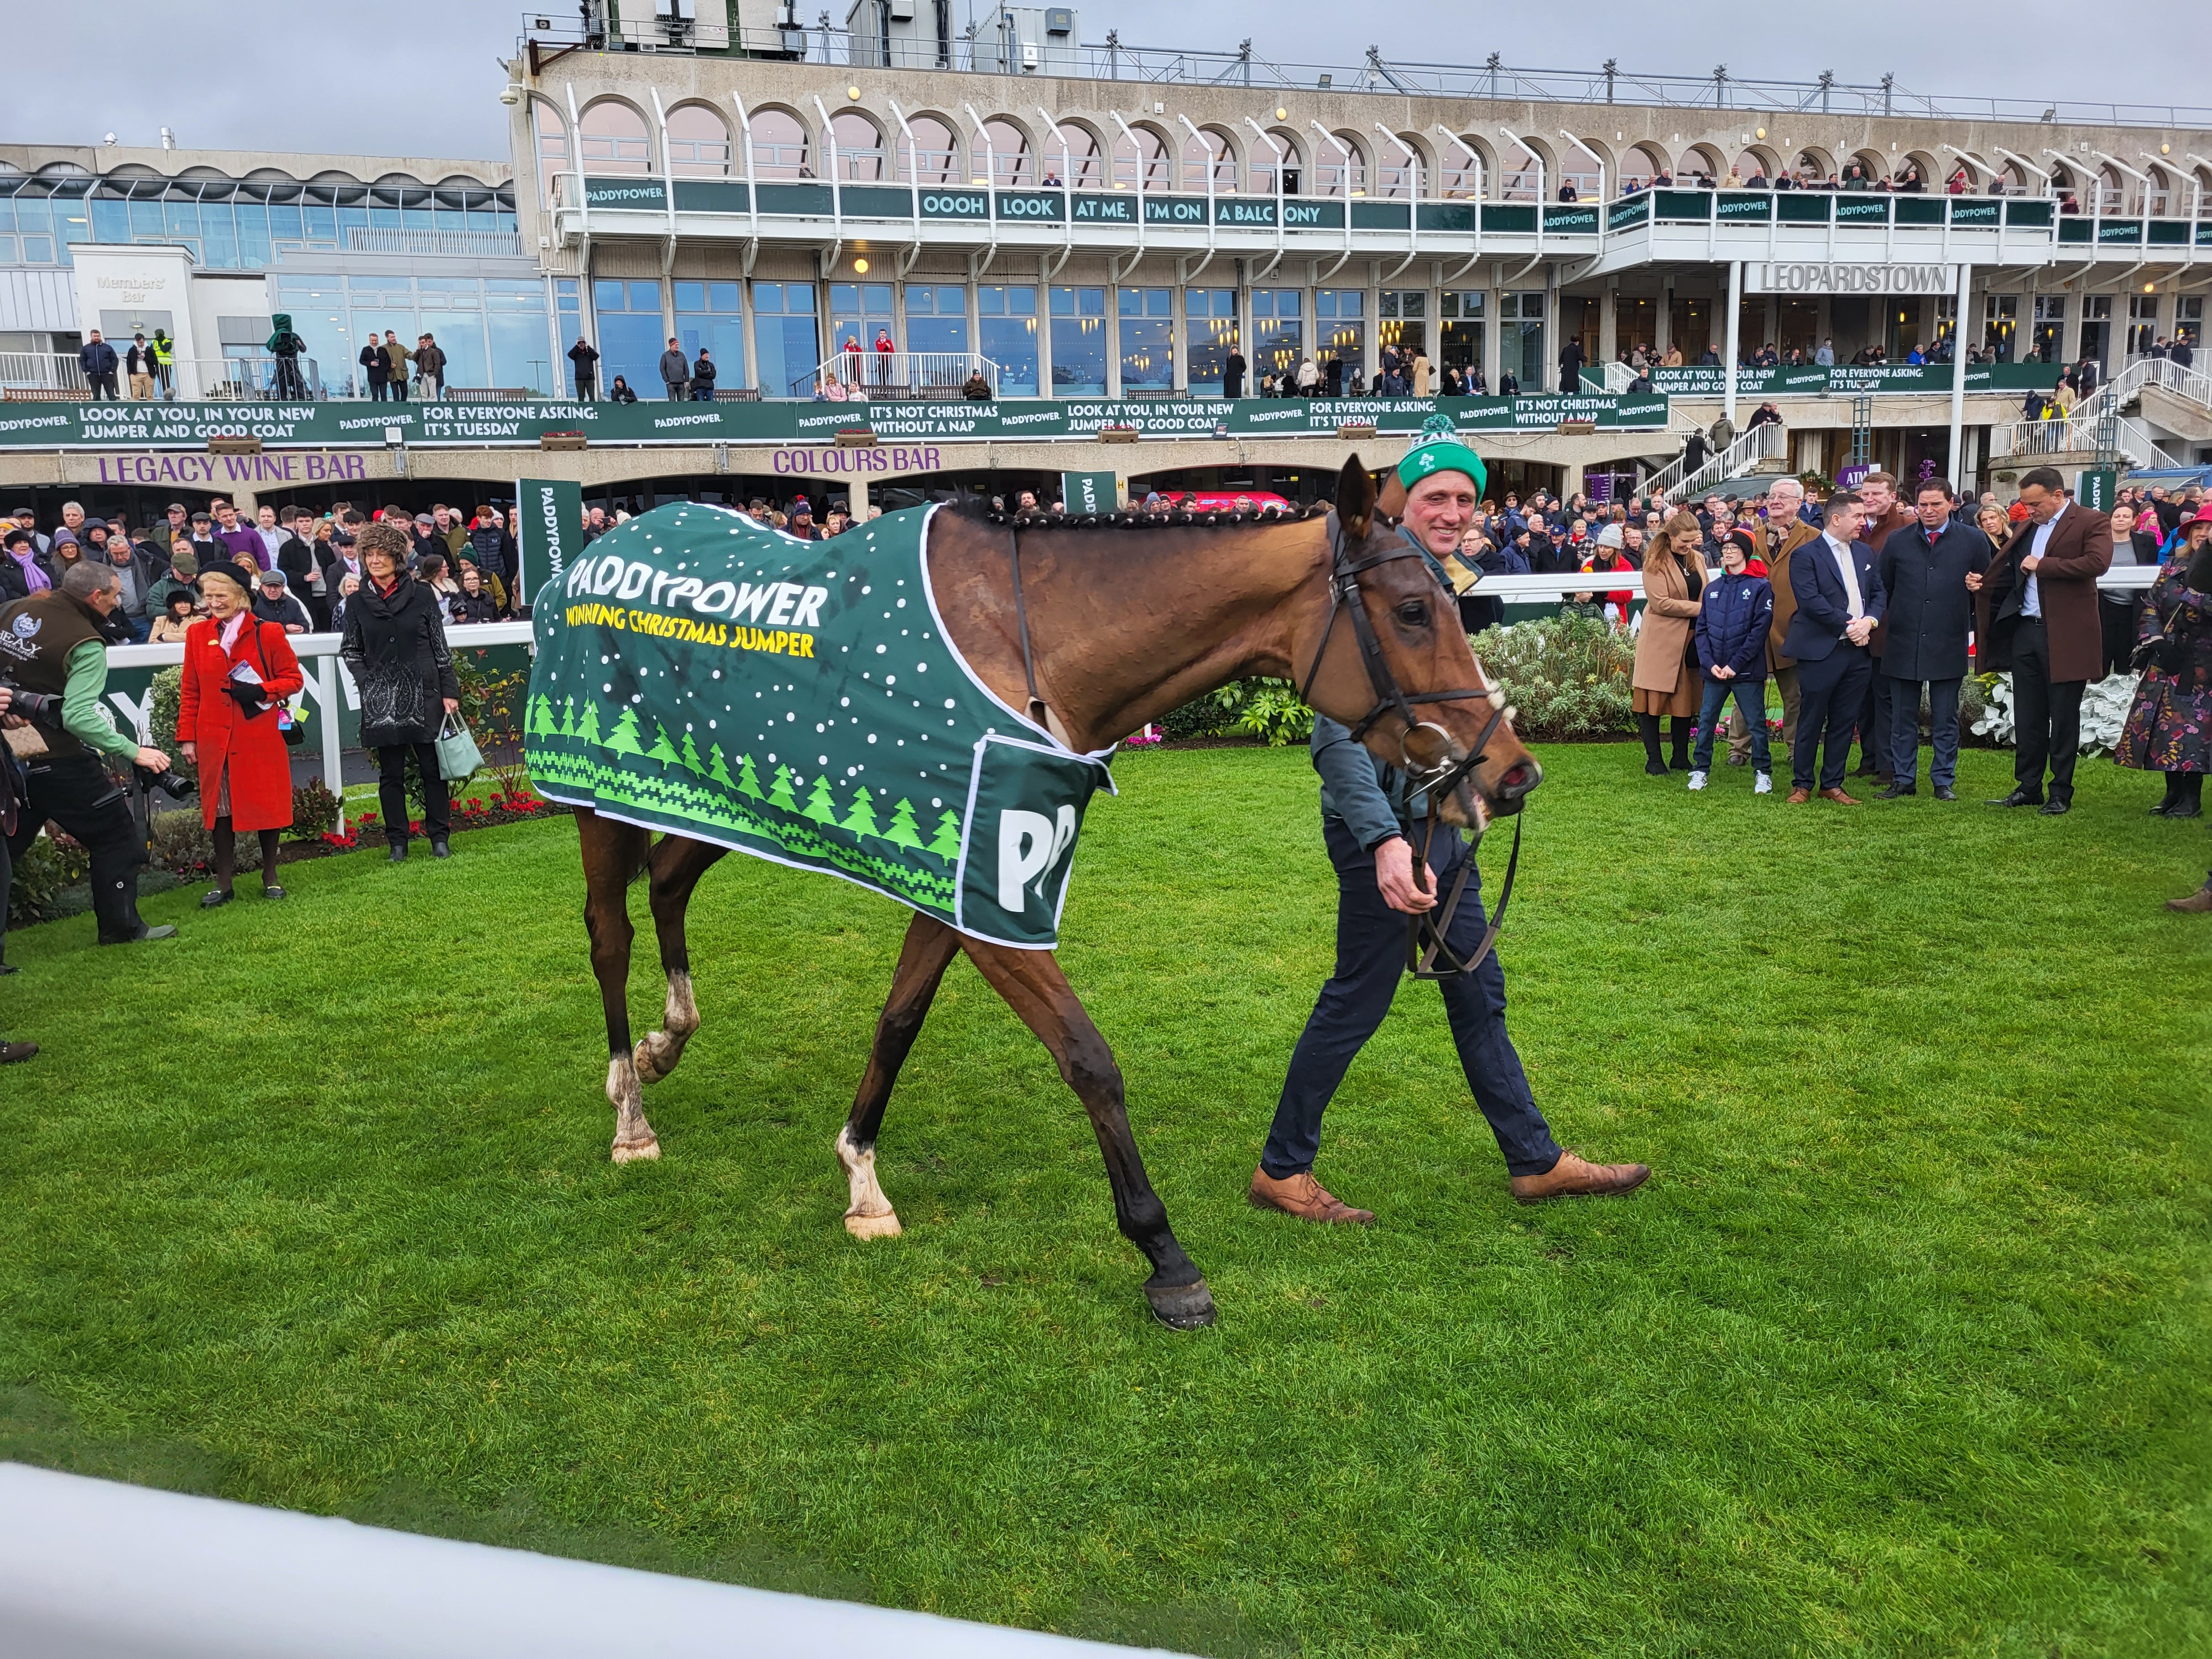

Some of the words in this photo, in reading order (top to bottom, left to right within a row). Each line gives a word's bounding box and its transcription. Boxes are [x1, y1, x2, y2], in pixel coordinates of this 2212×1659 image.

[585, 186, 667, 202] PADDYPOWER.
[924, 196, 984, 214] OOOH
[1003, 199, 1055, 216] LOOK
[1076, 200, 1097, 217] AT
[1101, 201, 1130, 221] ME,
[1146, 202, 1170, 219] I'M
[1173, 204, 1201, 220] ON
[1218, 205, 1231, 221] A
[1717, 201, 1770, 214] ADDYPOWER.
[1835, 204, 1886, 216] ADDYPOWER.
[1950, 206, 1998, 219] ADDYPOWER.
[1543, 214, 1597, 227] ADDYPOWER.
[1761, 264, 1948, 291] LEOPARDSTOWN
[121, 291, 145, 302] Bar
[1655, 371, 1681, 380] LOOK
[1682, 370, 1694, 380] AT
[1695, 370, 1717, 381] YOU,
[1736, 369, 1754, 380] OUR
[1756, 369, 1776, 379] NEW
[1786, 374, 1827, 385] PADDYPOWER.
[1830, 369, 1847, 378] FOR
[1849, 368, 1891, 378] EVERYONE
[1891, 368, 1923, 378] ASKING:
[1964, 372, 1991, 381] DYPOWER.
[1690, 382, 1710, 391] AND
[1740, 380, 1764, 390] COAT
[1829, 380, 1844, 389] IT'S
[1068, 404, 1104, 416] LOOK
[1105, 404, 1121, 416] AT
[1122, 404, 1152, 418] YOU,
[1155, 404, 1168, 416] IN
[1171, 404, 1205, 415] YOUR
[1207, 403, 1234, 415] NEW
[1310, 402, 1333, 414] FOR
[1335, 401, 1391, 413] EVERYONE
[1393, 401, 1436, 413] ASKING:
[1516, 400, 1533, 411] IT'S
[1536, 399, 1559, 410] NOT
[1561, 398, 1617, 410] CHRISTMAS
[1618, 403, 1667, 417] PADDYPOWER.
[79, 408, 131, 421] LOOK
[133, 408, 154, 421] AT
[156, 408, 200, 423] YOU,
[204, 408, 223, 421] IN
[226, 408, 275, 421] YOUR
[278, 407, 315, 421] NEW
[422, 406, 455, 420] FOR
[458, 406, 536, 420] EVERYONE
[539, 406, 598, 420] ASKING:
[870, 406, 893, 419] IT'S
[895, 406, 925, 418] NOT
[927, 405, 998, 418] CHRISTMAS
[1001, 411, 1064, 426] PADDYPOWER.
[1250, 409, 1305, 424] PADDYPOWER.
[1459, 406, 1511, 420] PADDYPOWER.
[1514, 412, 1566, 424] WITHOUT
[1577, 411, 1599, 422] NAP
[0, 416, 72, 431] DDYPOWER.
[339, 414, 418, 431] PADDYPOWER.
[654, 413, 724, 429] PADDYPOWER.
[798, 413, 865, 429] PADDYPOWER.
[870, 420, 935, 434] WITHOUT
[936, 421, 947, 432] A
[949, 420, 975, 432] NAP
[1147, 418, 1185, 430] GOOD
[1187, 418, 1220, 430] COAT
[1310, 415, 1329, 427] IT'S
[1331, 415, 1380, 427] TUESDAY
[81, 424, 149, 439] JUMPER
[153, 424, 190, 438] AND
[194, 424, 249, 439] GOOD
[252, 424, 295, 439] COAT
[424, 423, 451, 436] IT'S
[453, 422, 520, 436] TUESDAY
[774, 447, 888, 473] COLOURS
[893, 447, 940, 471] BAR
[98, 455, 217, 483] LEGACY
[223, 455, 300, 482] WINE
[305, 453, 366, 480] BAR
[1846, 470, 1867, 484] ATM
[567, 555, 829, 627] PADDYPOWER
[566, 603, 626, 629] WINNING
[628, 609, 727, 647] CHRISTMAS
[729, 625, 815, 659] JUMPER
